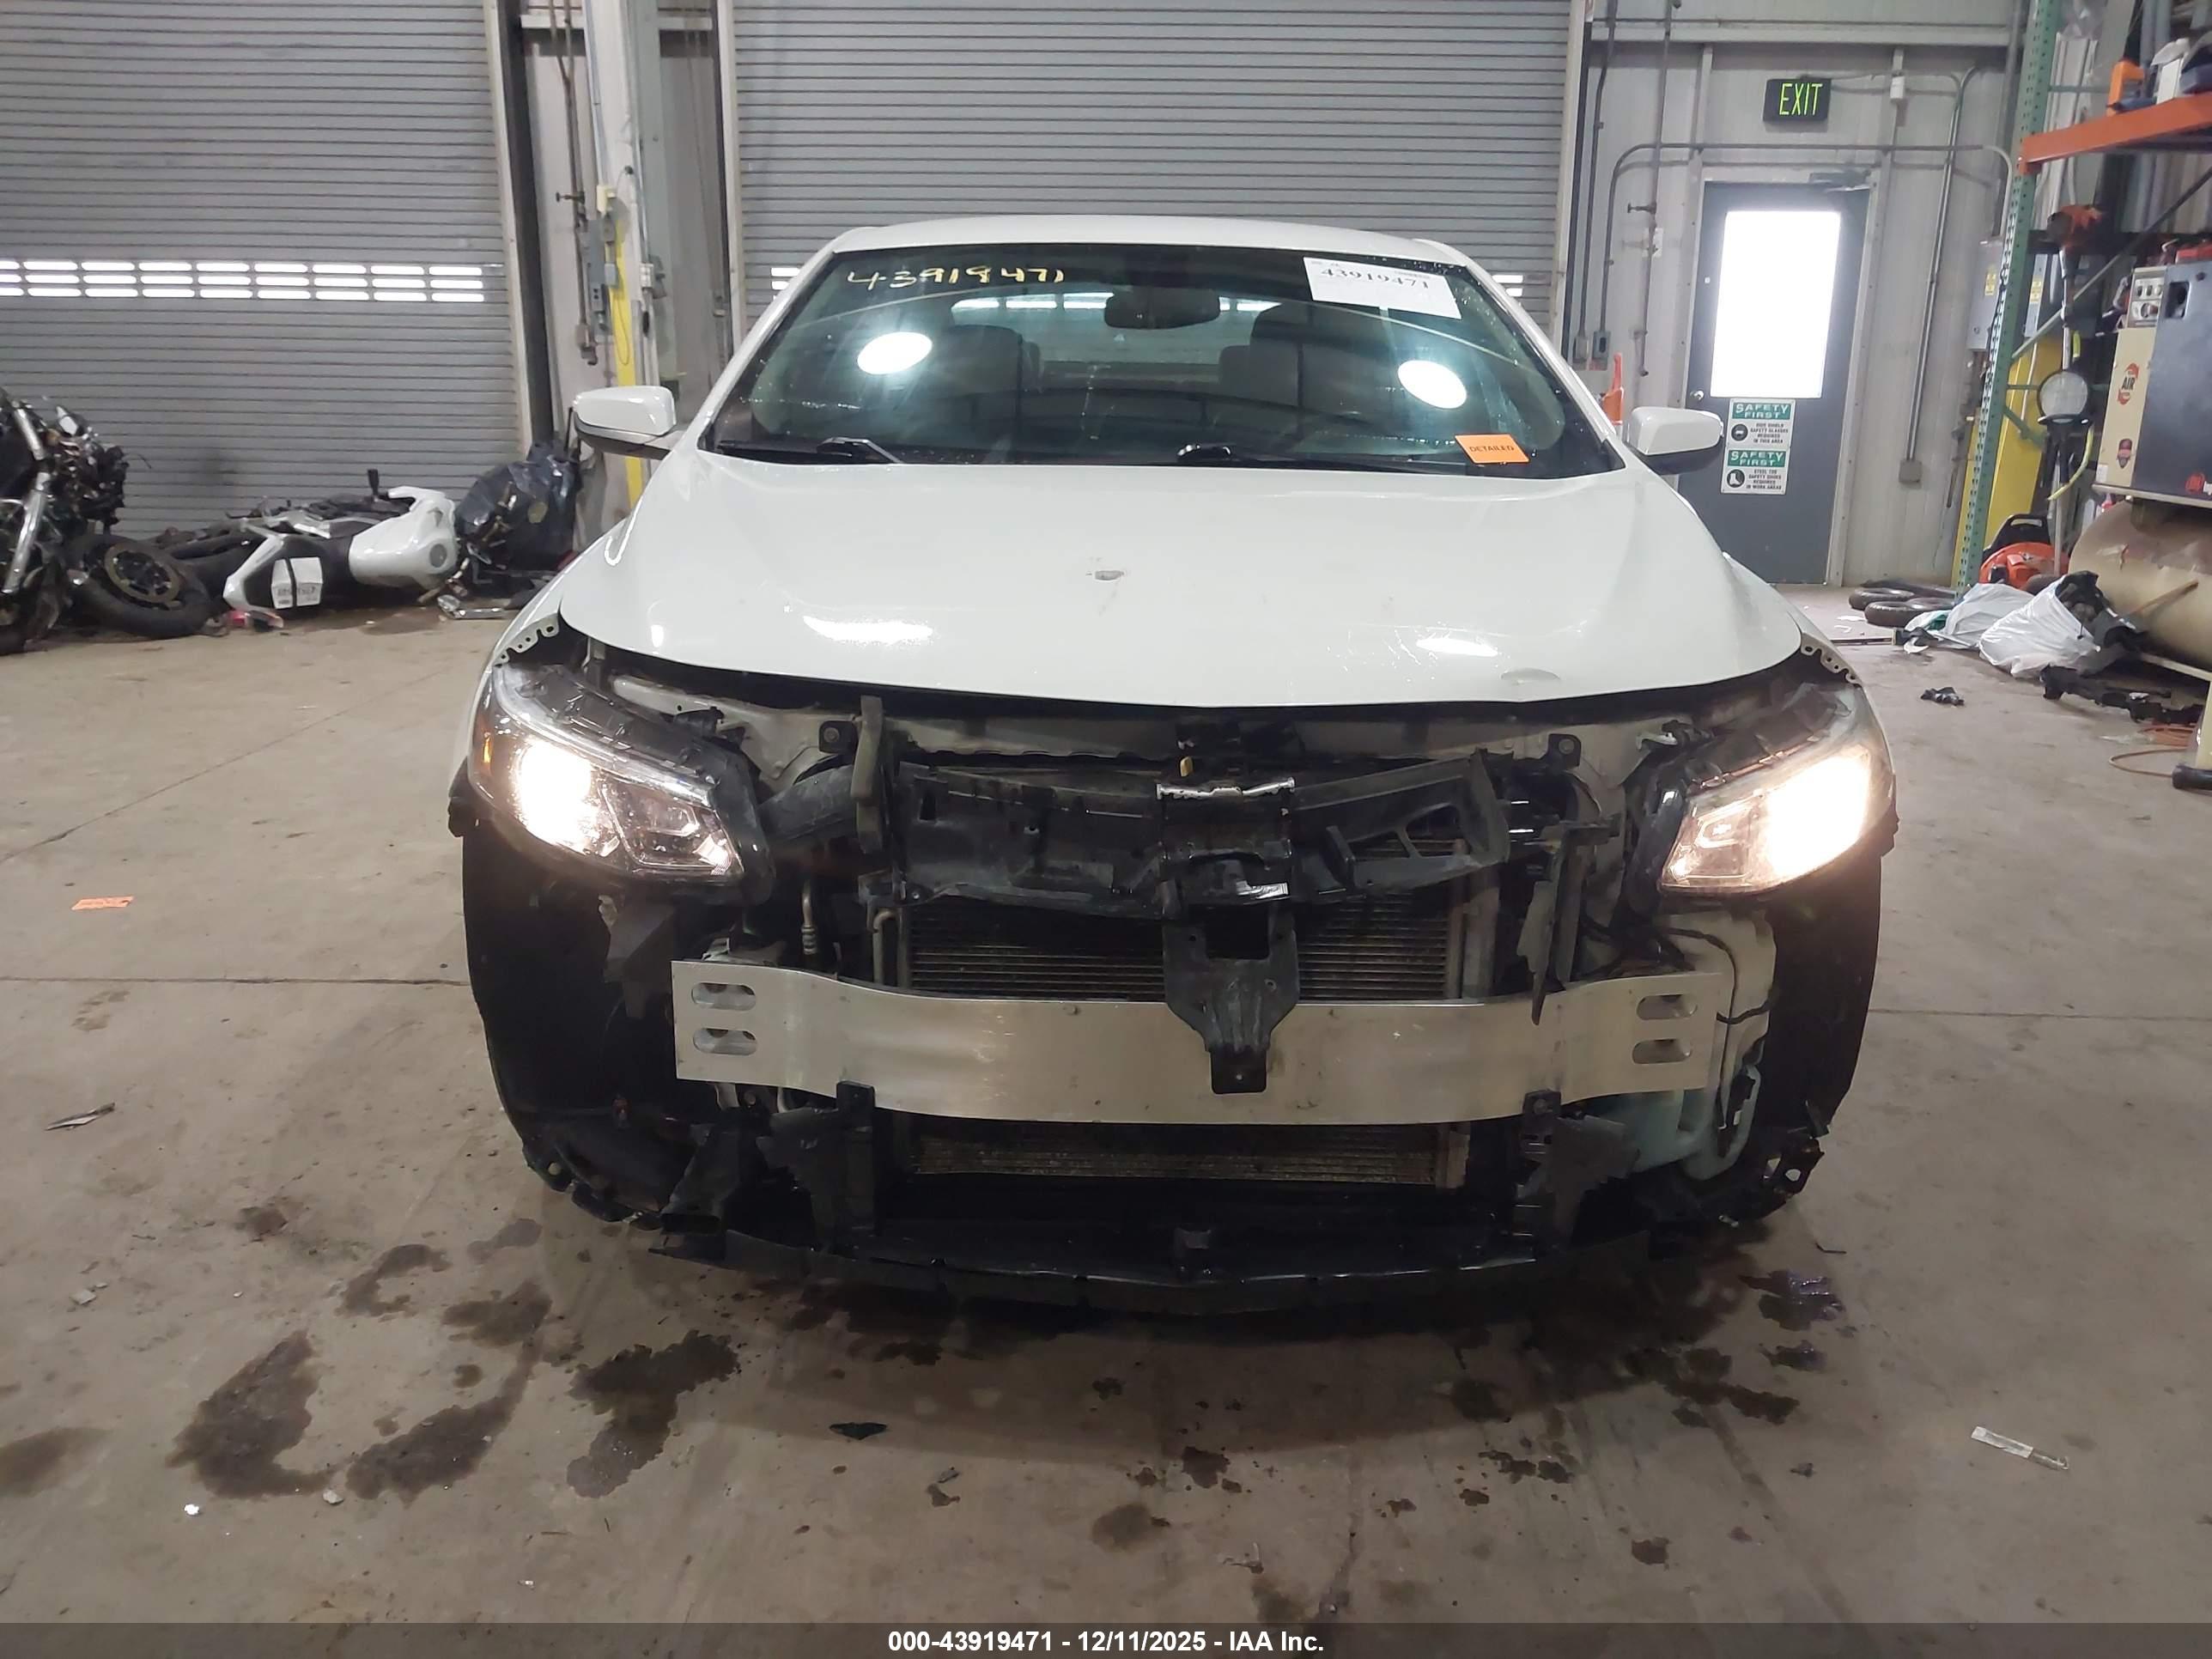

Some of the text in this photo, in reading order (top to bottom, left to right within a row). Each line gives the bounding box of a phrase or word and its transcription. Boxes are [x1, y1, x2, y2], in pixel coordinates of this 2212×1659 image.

[1779, 82, 1823, 115] EXIT
[1735, 403, 1789, 414] SAFETY
[1730, 451, 1784, 462] SAFETY
